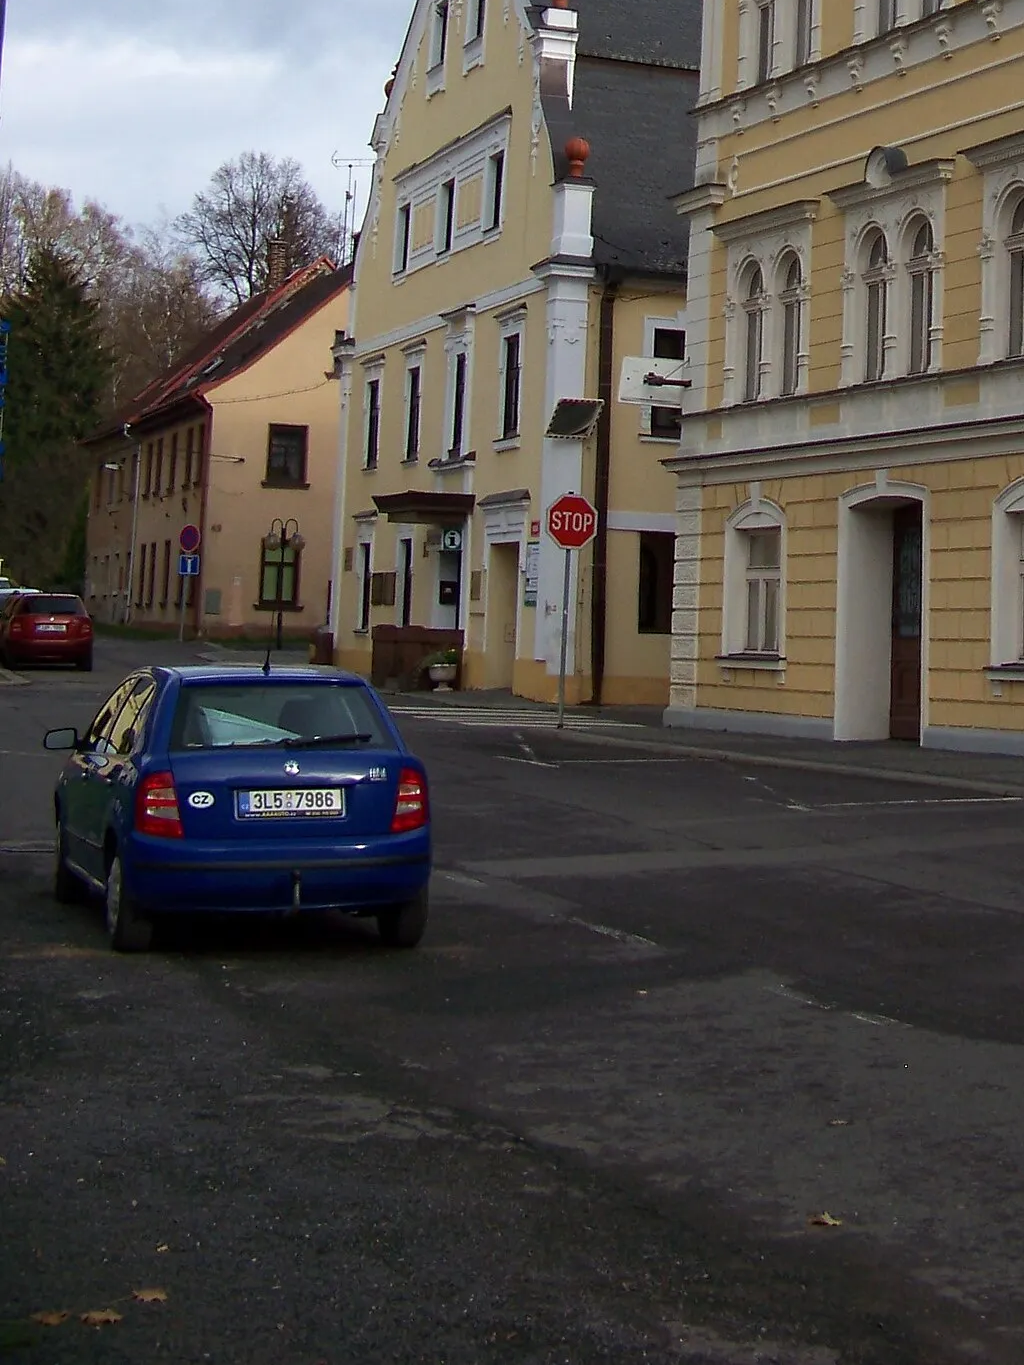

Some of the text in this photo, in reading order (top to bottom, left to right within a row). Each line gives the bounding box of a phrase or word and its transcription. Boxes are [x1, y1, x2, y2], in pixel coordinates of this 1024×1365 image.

[552, 511, 593, 532] STOP
[191, 794, 209, 805] CZ
[253, 791, 334, 809] 3L5 7986
